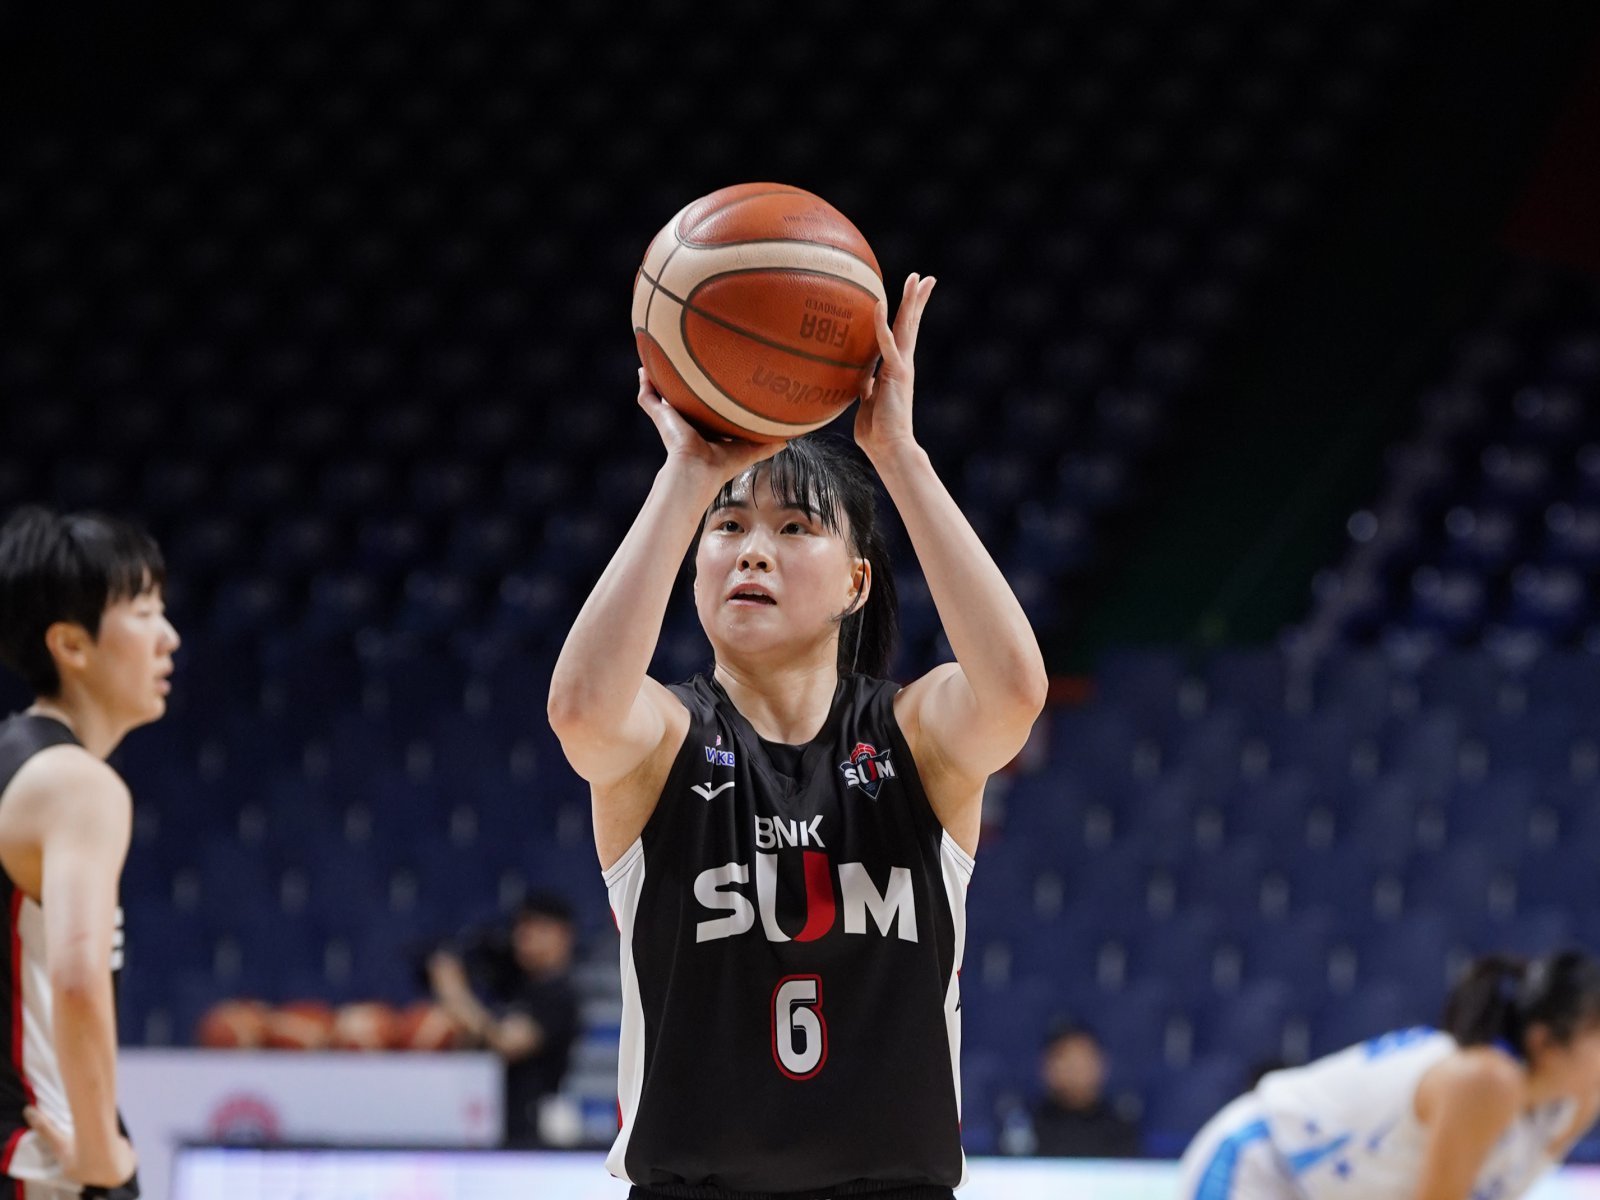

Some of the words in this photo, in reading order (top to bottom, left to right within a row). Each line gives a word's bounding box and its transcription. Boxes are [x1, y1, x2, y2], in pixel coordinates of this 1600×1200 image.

[799, 313, 850, 349] FIBA
[752, 365, 850, 405] molten
[844, 759, 896, 786] SUM
[754, 814, 826, 848] BNK
[693, 850, 919, 944] SUM
[772, 974, 828, 1081] 6
